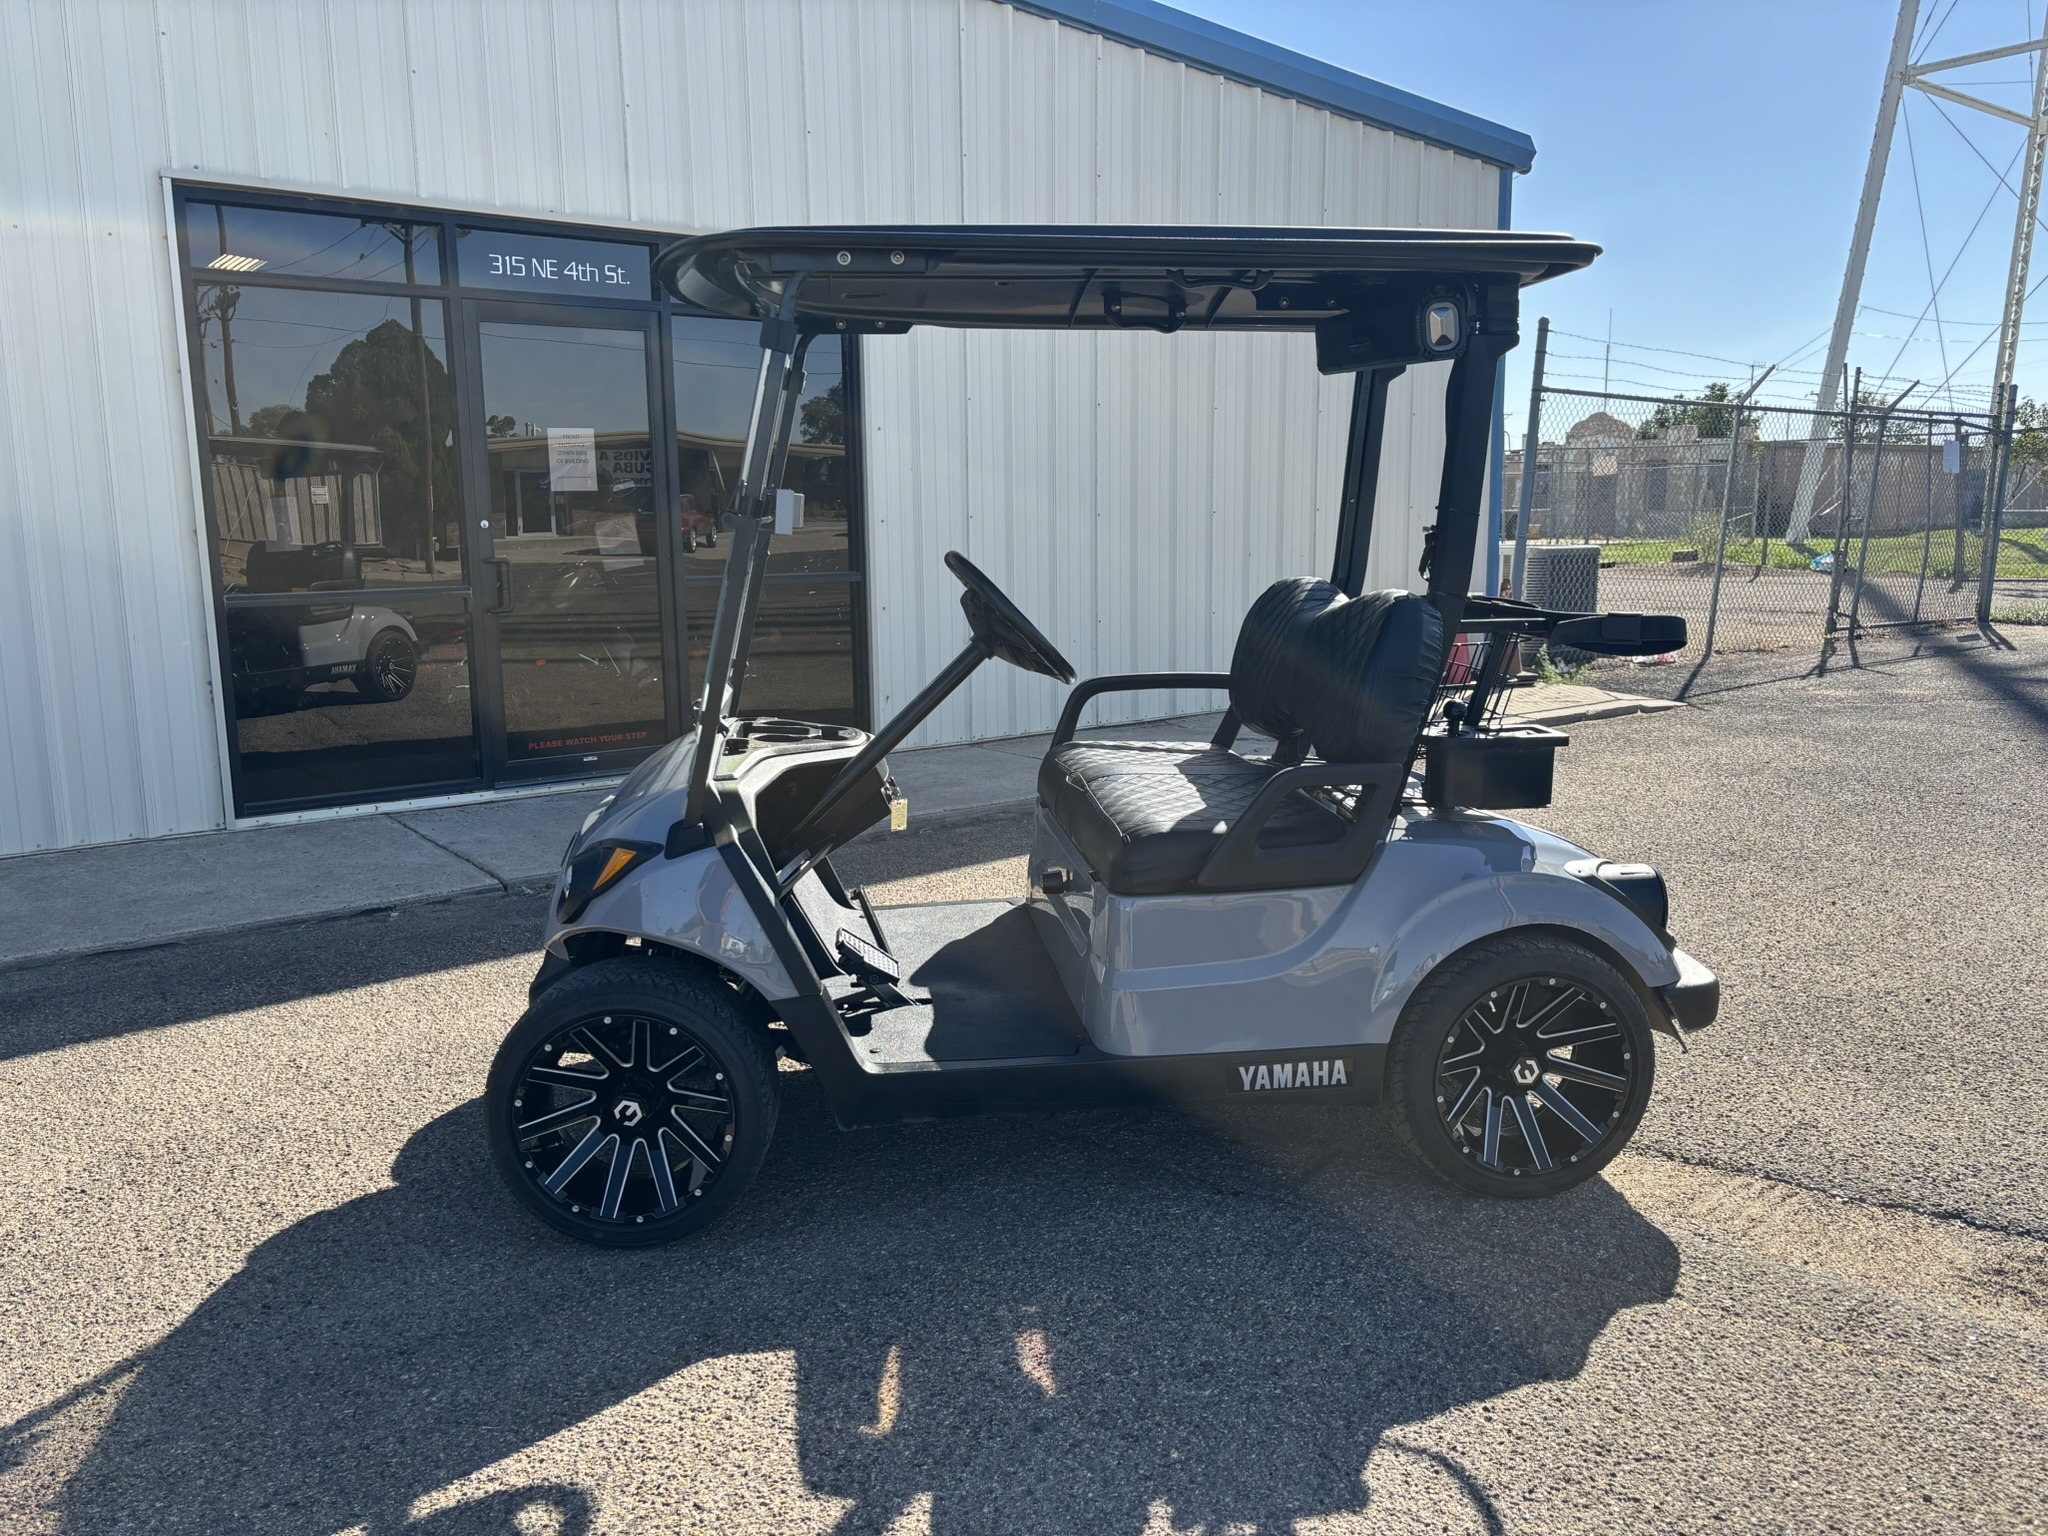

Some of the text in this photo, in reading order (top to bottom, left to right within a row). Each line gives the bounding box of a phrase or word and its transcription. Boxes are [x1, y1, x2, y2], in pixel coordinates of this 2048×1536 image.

[488, 253, 631, 285] 315 NE 4th St.
[528, 731, 648, 750] PLEASE WATCH YOUR STEP
[1238, 1058, 1348, 1092] YAMAHA
